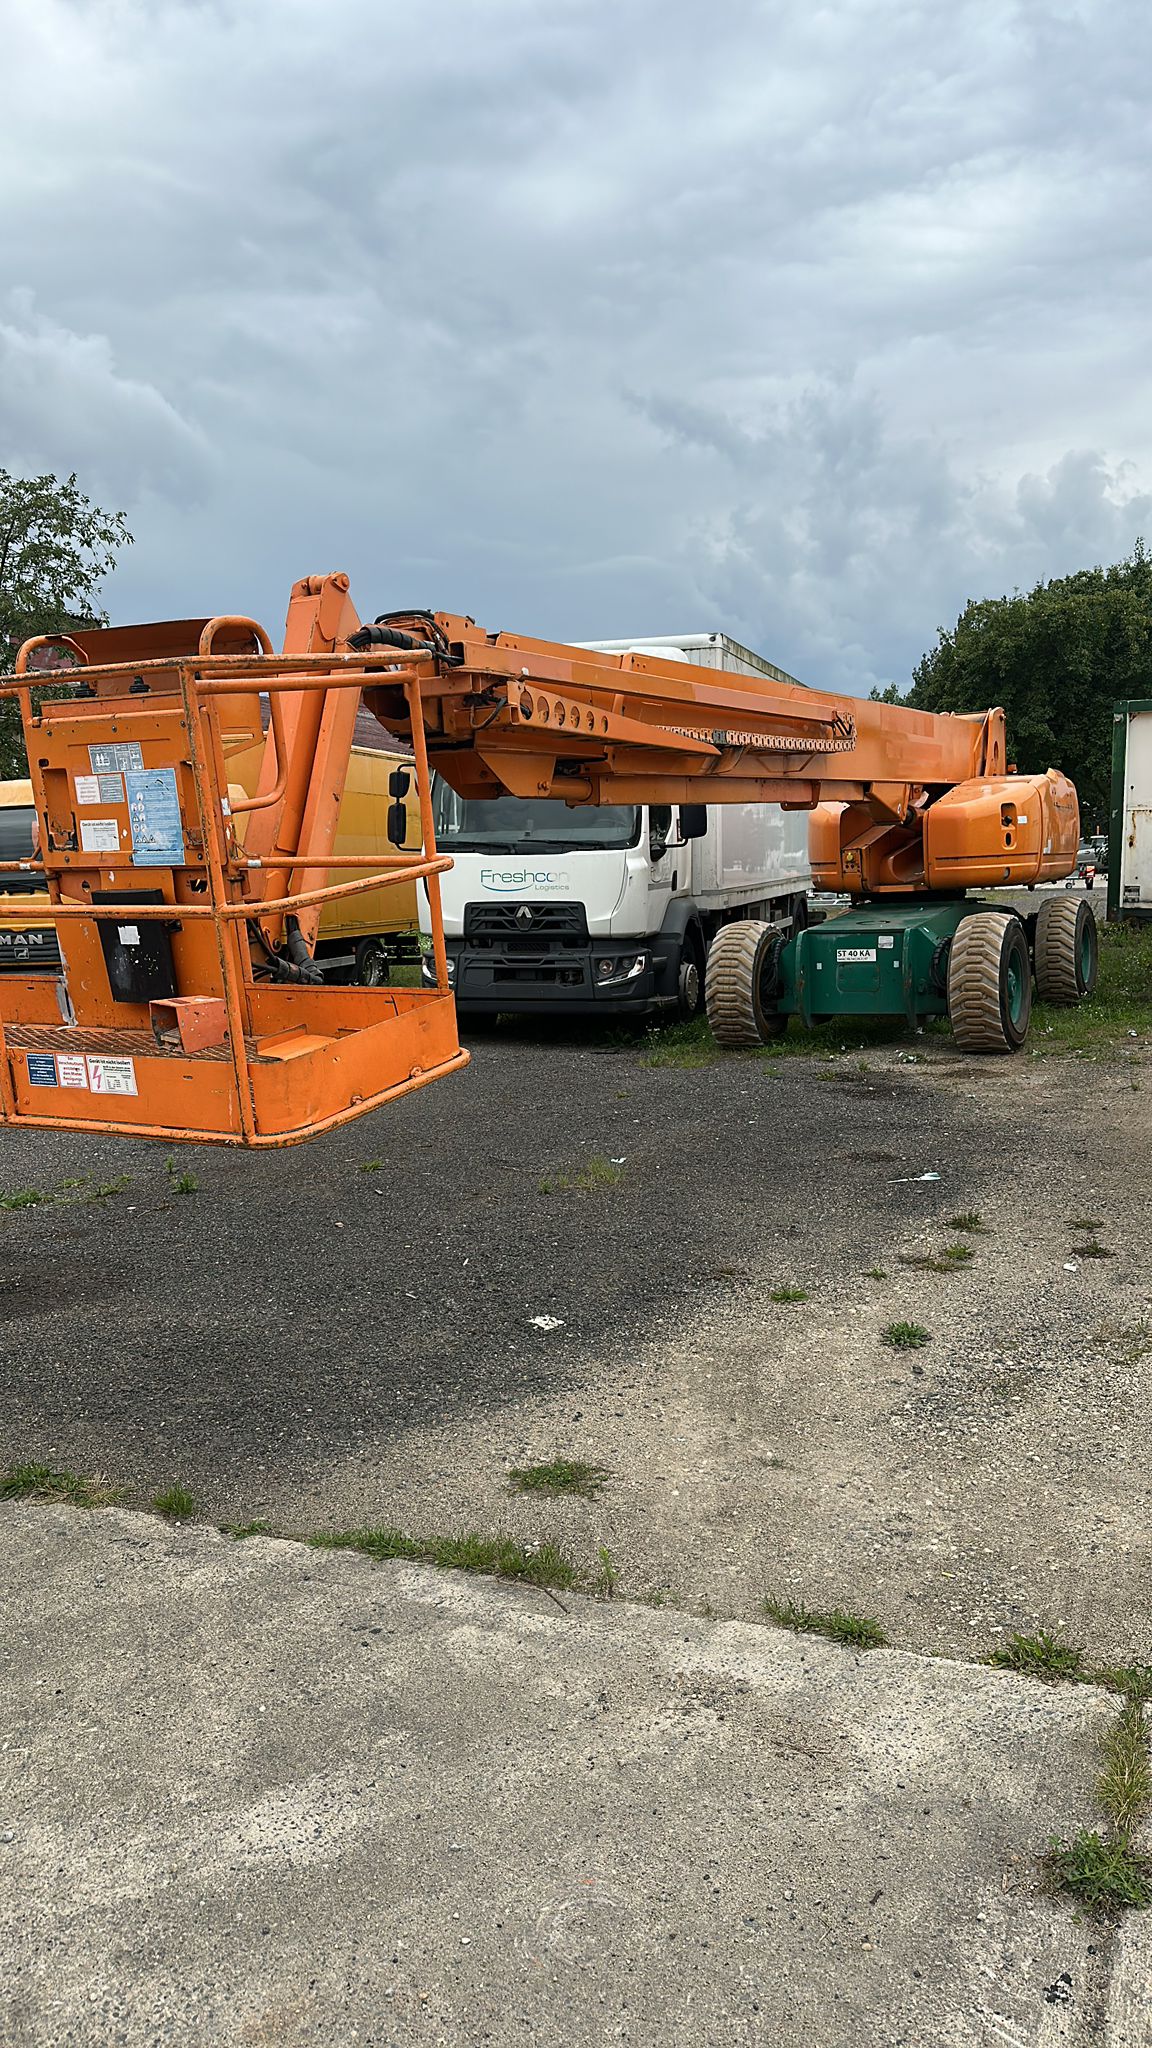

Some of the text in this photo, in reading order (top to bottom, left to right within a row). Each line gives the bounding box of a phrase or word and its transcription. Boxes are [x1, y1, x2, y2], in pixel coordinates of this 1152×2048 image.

[480, 869, 569, 883] Freshcon
[535, 884, 570, 892] Logistics
[0, 934, 43, 945] MAN
